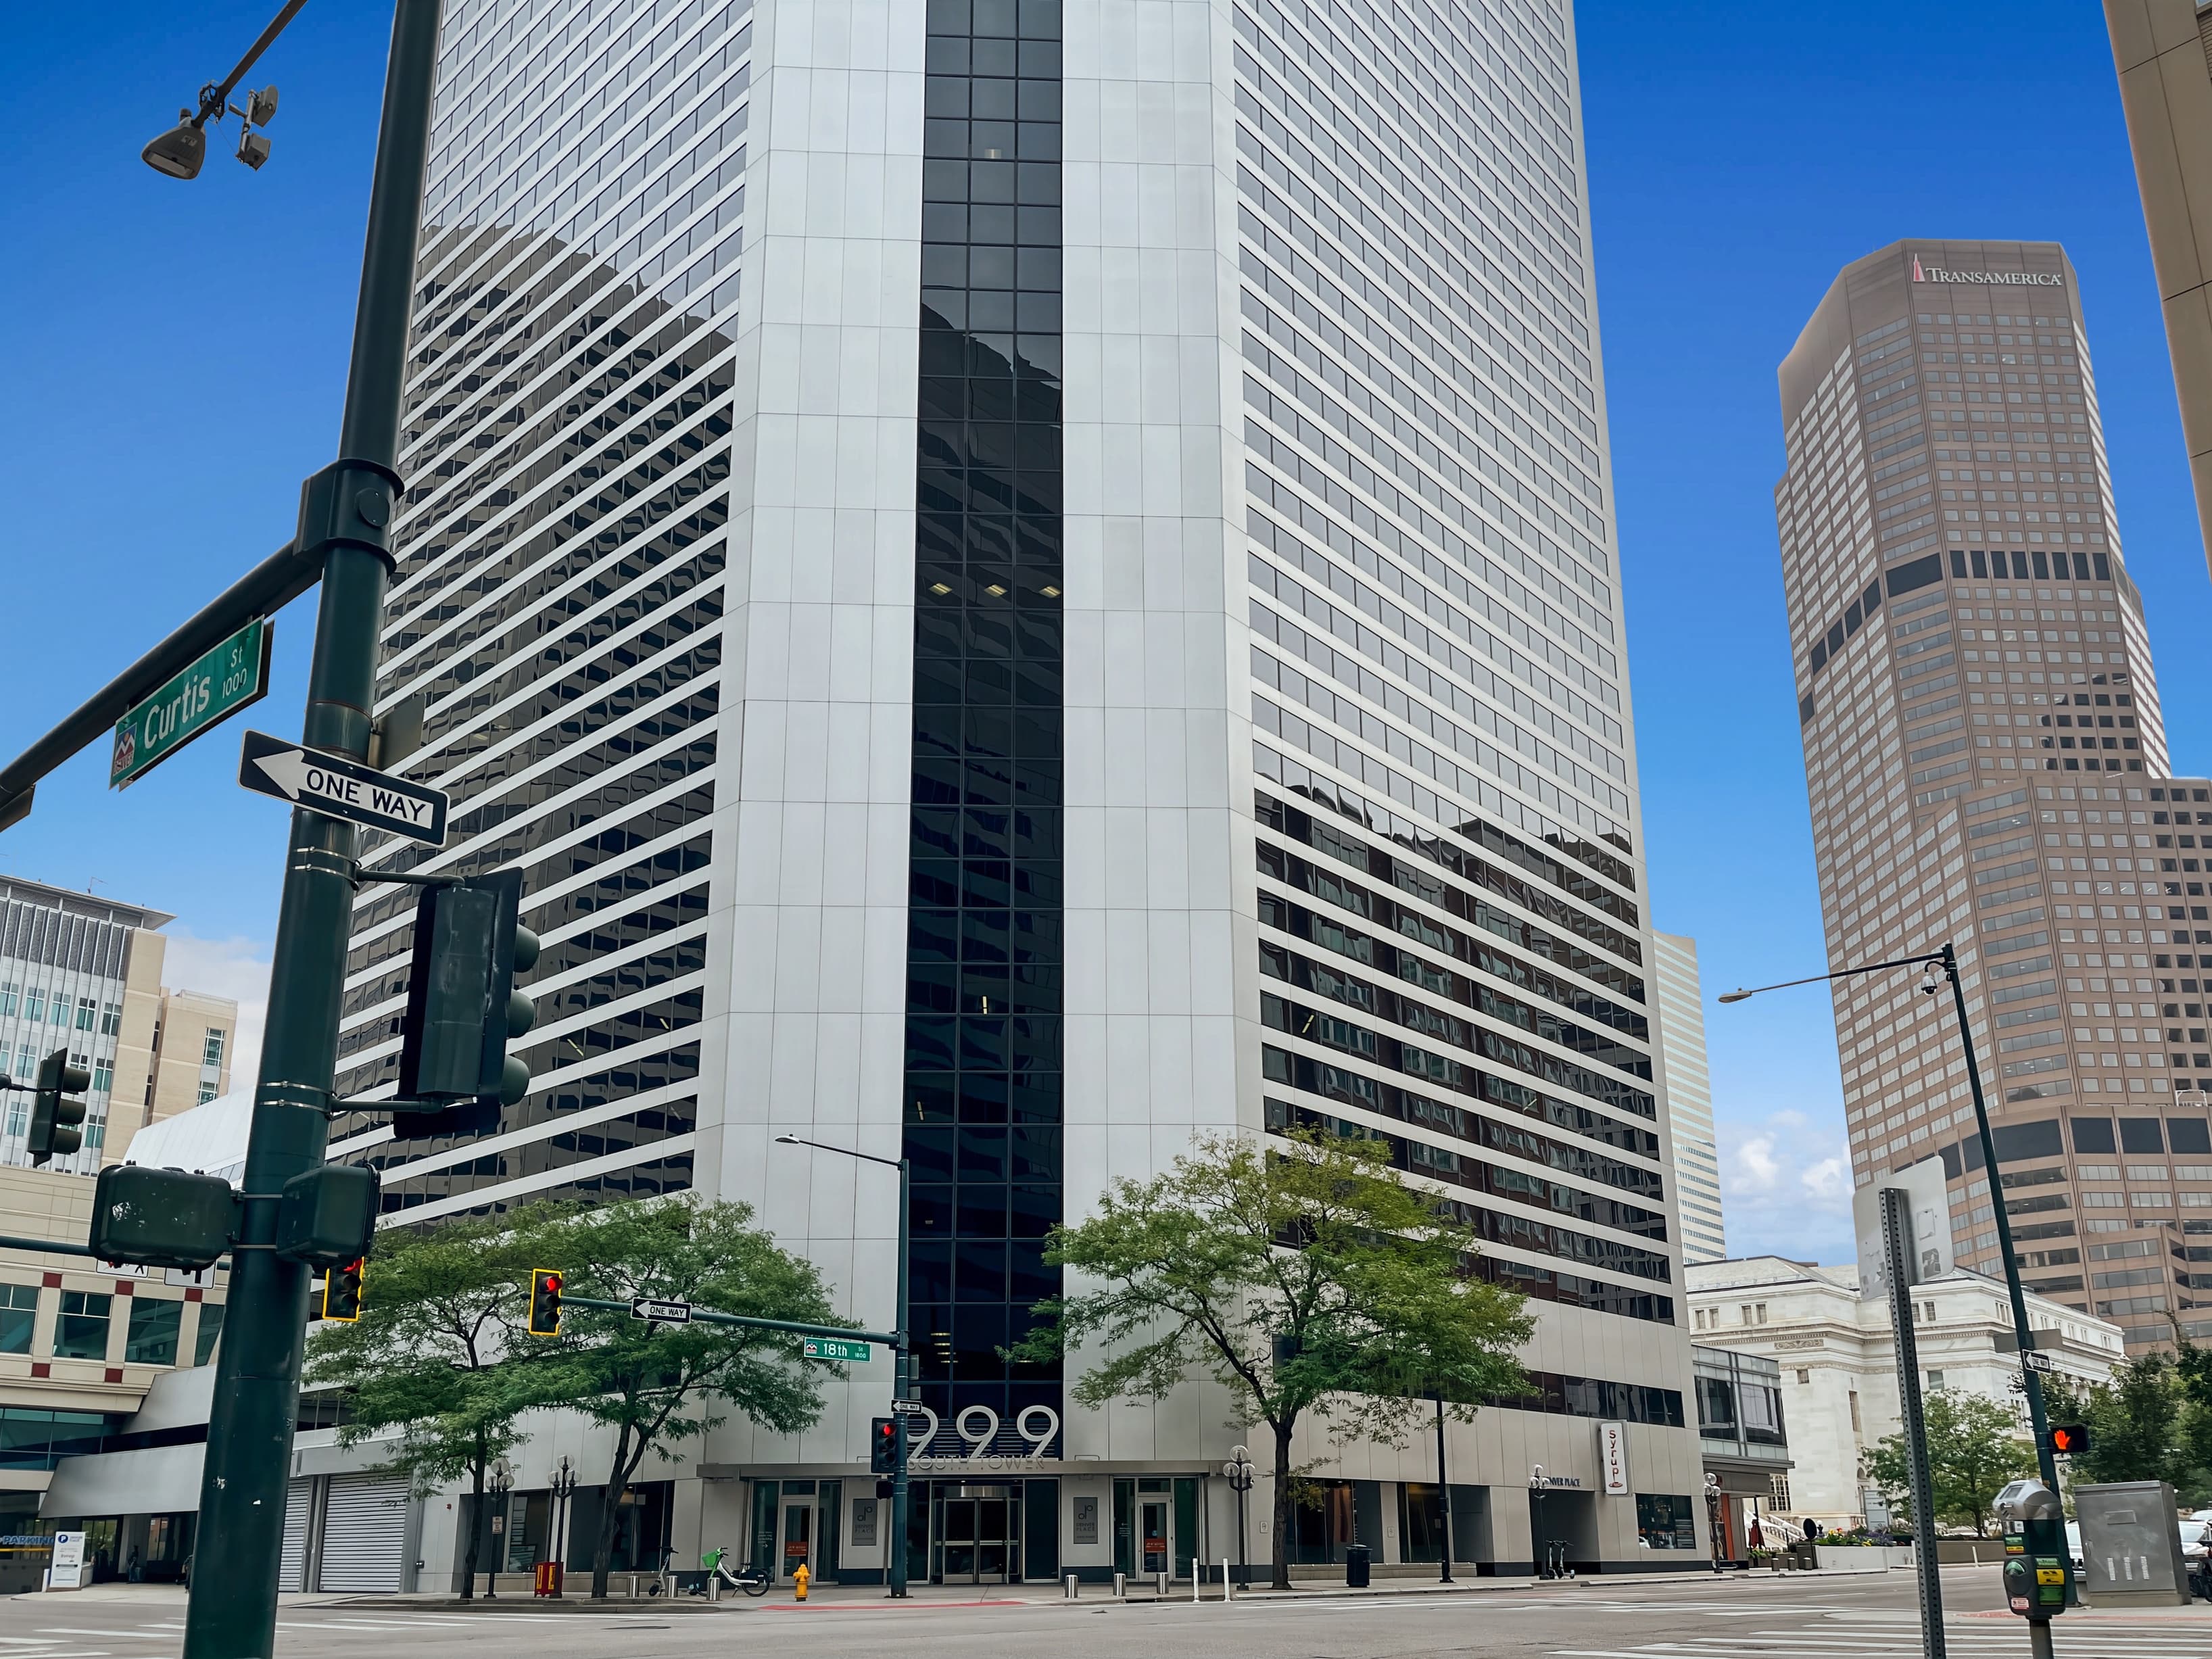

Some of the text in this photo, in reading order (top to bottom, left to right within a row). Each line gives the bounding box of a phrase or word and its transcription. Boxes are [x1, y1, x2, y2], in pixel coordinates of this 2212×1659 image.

[1925, 267, 2061, 285] TRANSAMERICA
[222, 668, 247, 698] 1000
[144, 646, 243, 749] Curtis St
[306, 769, 425, 821] ONE WAY
[650, 1306, 684, 1317] ONE WAY
[823, 1343, 847, 1357] 18th
[907, 1405, 1059, 1459] 999
[907, 1455, 1044, 1470] SOUTH TOWER
[1609, 1430, 1620, 1483] Syrup
[1564, 1478, 1581, 1487] PLACE
